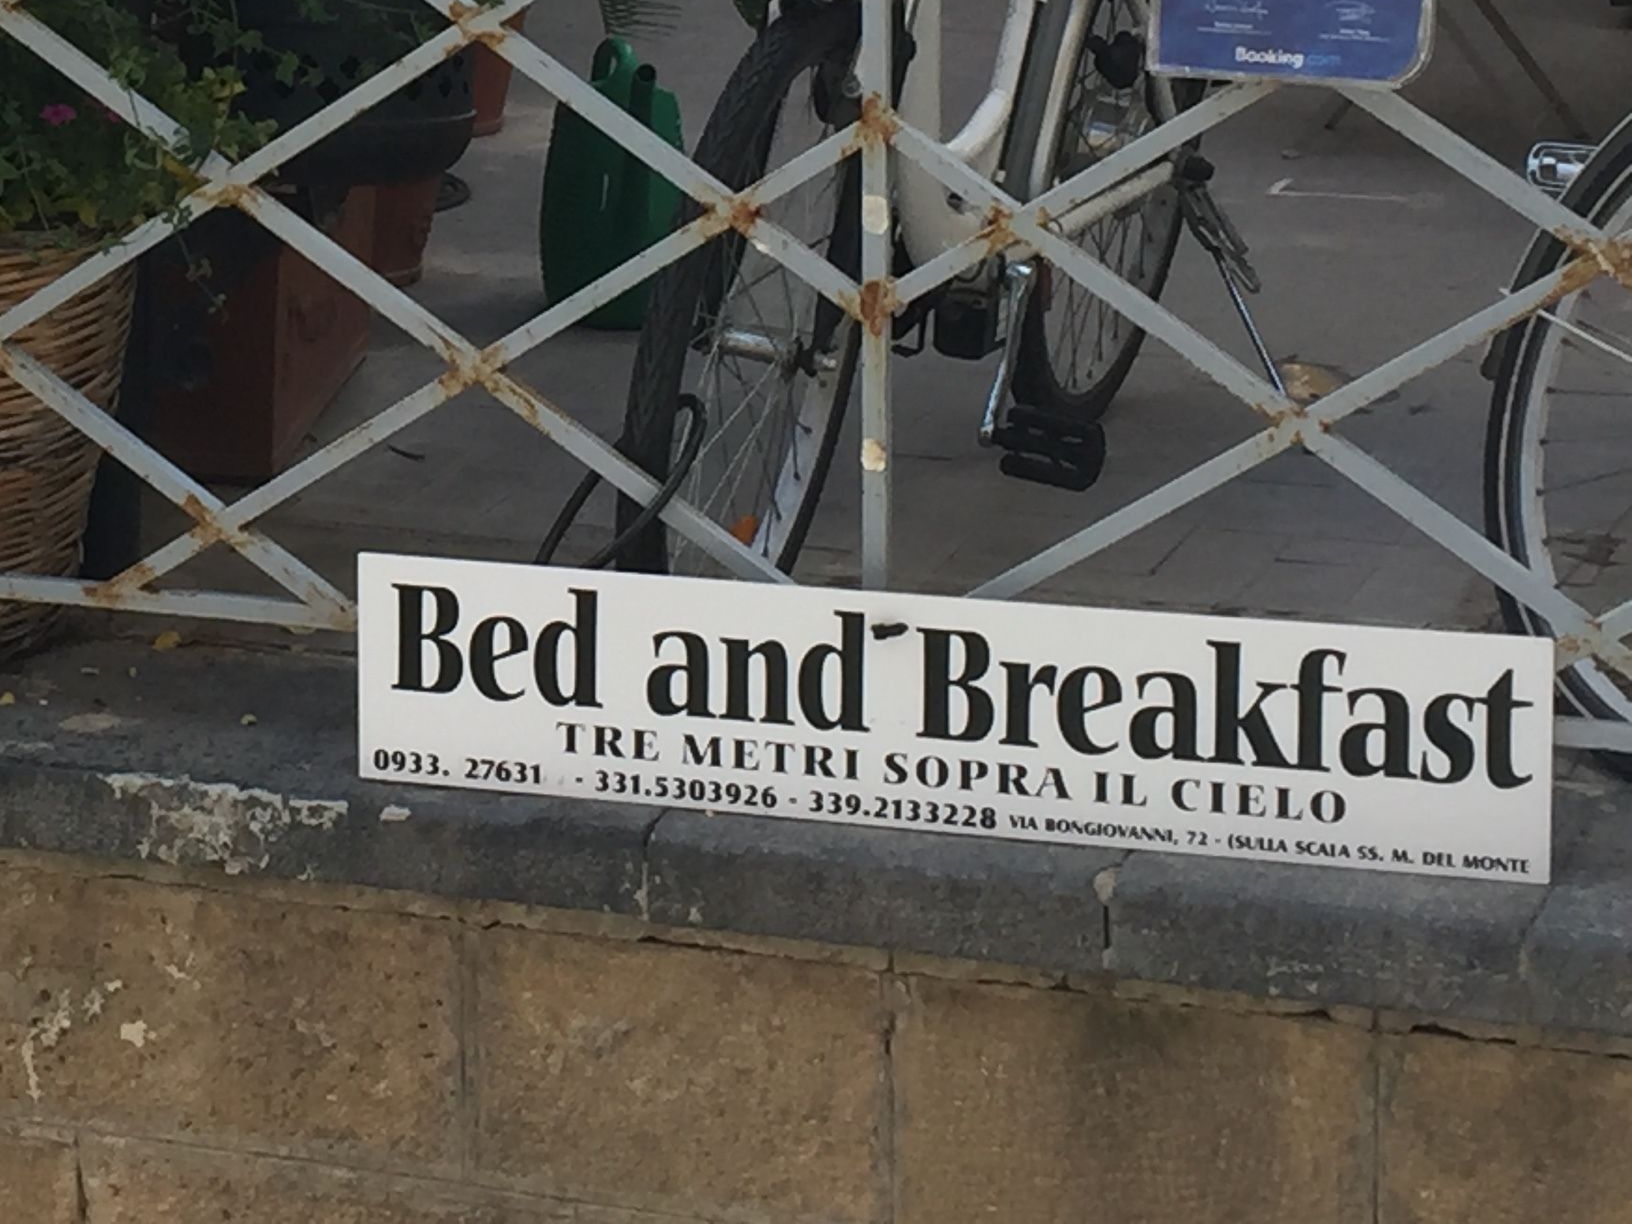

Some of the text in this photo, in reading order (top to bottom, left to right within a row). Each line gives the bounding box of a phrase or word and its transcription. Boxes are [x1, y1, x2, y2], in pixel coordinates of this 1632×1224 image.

[391, 583, 1534, 789] Bed and Breakfast
[373, 748, 450, 776] 0933.
[464, 757, 543, 785] 27631
[594, 769, 778, 809] 331.5303926
[808, 790, 998, 831] 339.2133228
[1009, 814, 1038, 831] VIA
[1186, 831, 1208, 846] 72
[1422, 851, 1456, 868] DEL
[1462, 855, 1531, 874] MONTE
[556, 721, 1346, 825] TRE METRI SOPRA IL CIELO
